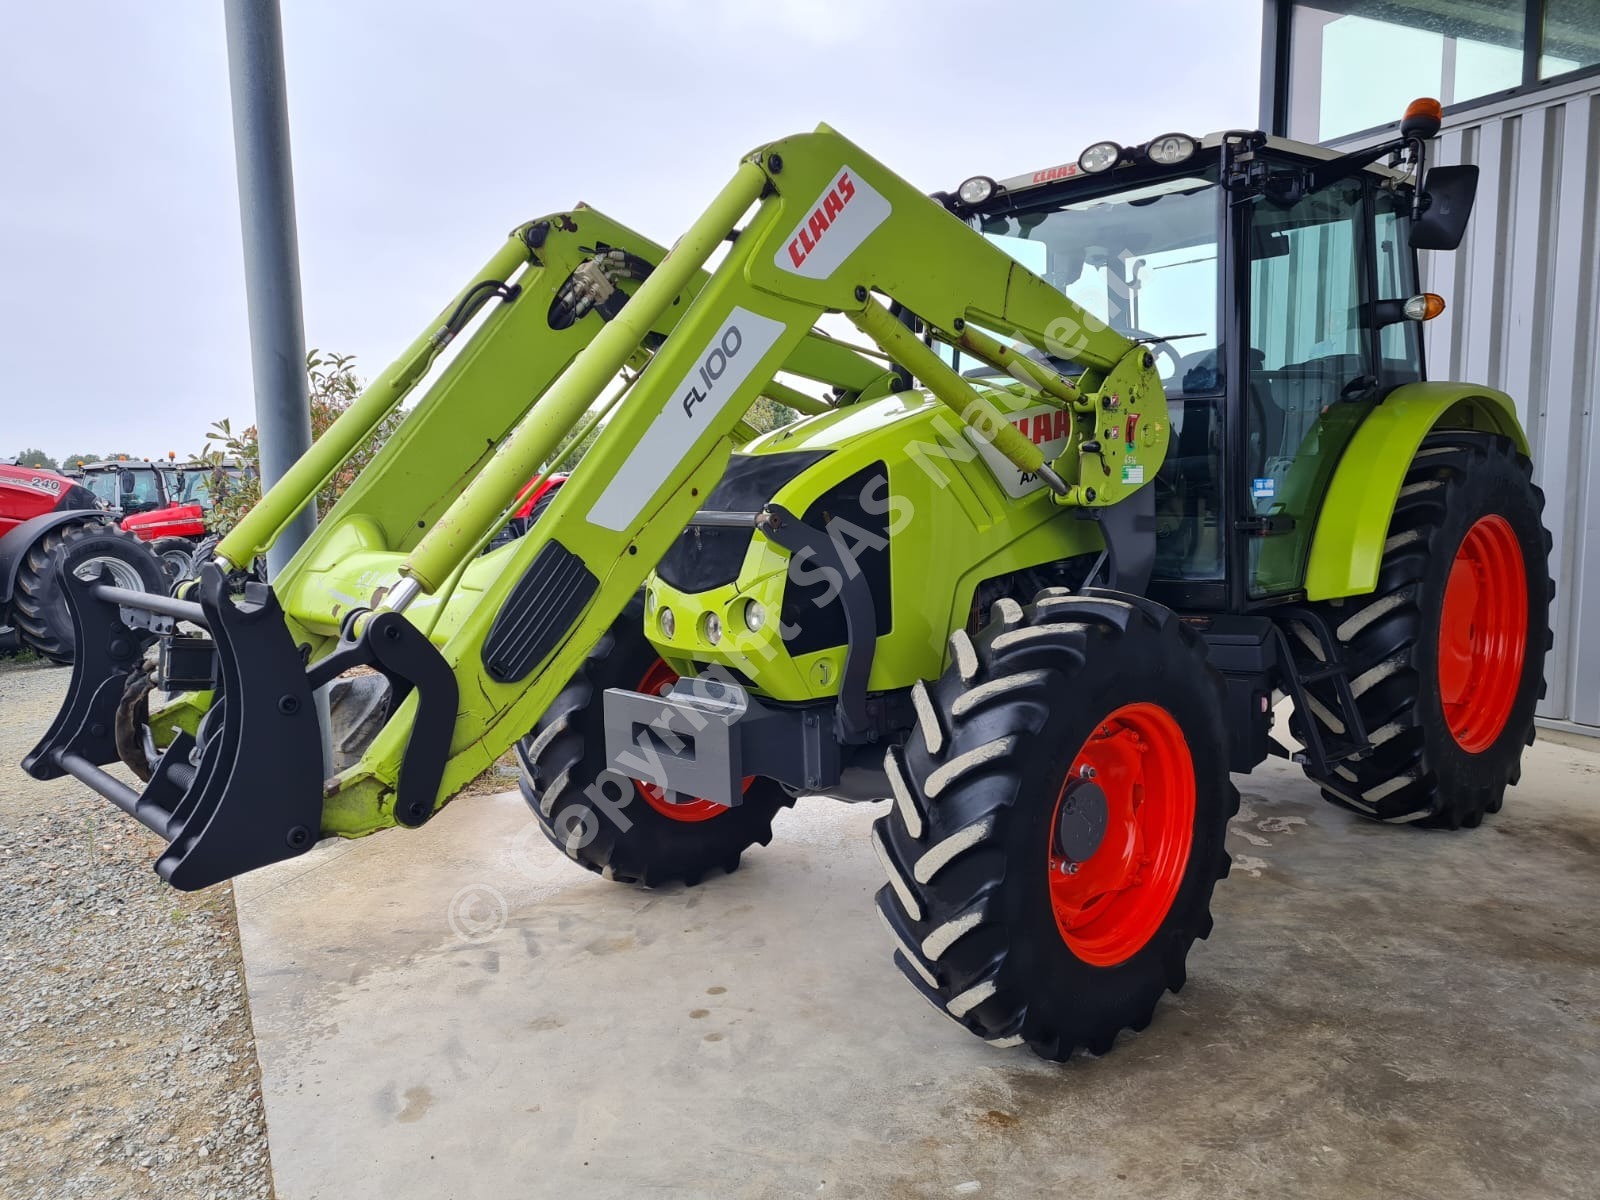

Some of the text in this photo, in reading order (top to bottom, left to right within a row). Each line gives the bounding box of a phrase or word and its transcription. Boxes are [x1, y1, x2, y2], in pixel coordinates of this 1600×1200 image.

[1033, 164, 1077, 183] CLAAS
[788, 172, 855, 269] CLAAS
[1012, 409, 1070, 445] LAA
[31, 477, 60, 491] 240
